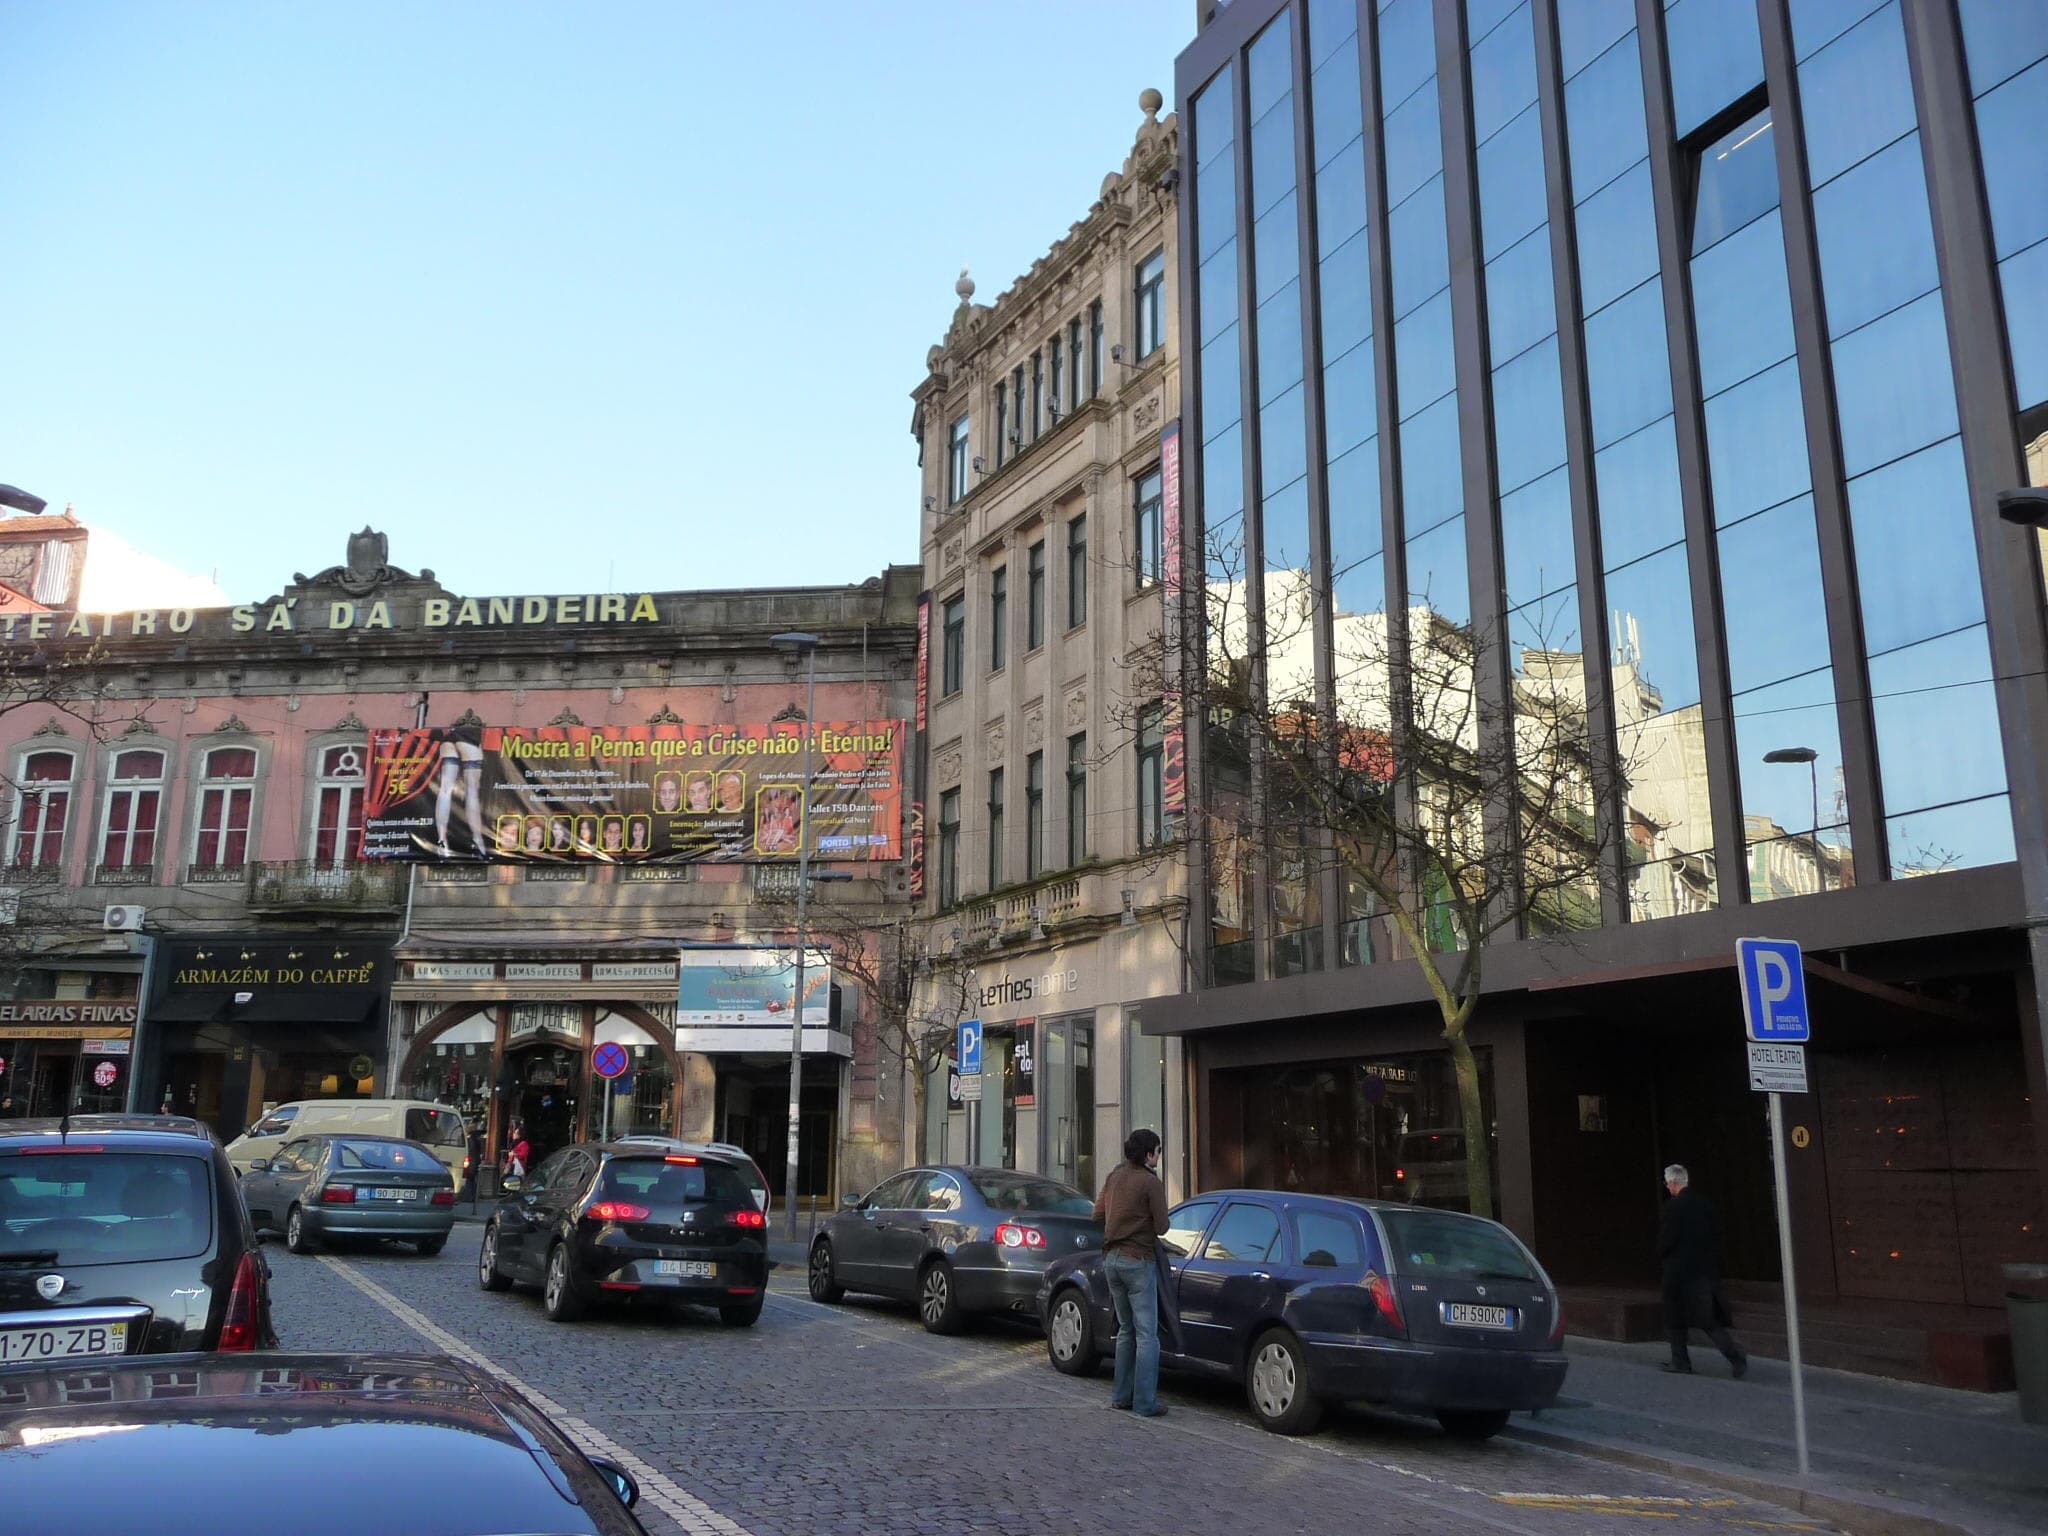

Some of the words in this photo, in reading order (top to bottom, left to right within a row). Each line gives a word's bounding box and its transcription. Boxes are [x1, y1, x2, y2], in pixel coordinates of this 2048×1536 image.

[0, 608, 193, 640] TEATRO
[231, 597, 298, 632] SÁ
[329, 600, 393, 630] DA
[424, 593, 659, 627] BANDEIRA
[500, 734, 570, 759] Mostra
[574, 739, 586, 758] a
[590, 734, 646, 758] Perna
[650, 739, 686, 765] que
[691, 740, 704, 756] a
[708, 731, 757, 756] Crise
[762, 731, 799, 755] não
[821, 727, 892, 754] Eterna!
[388, 778, 409, 796] 5€
[808, 804, 831, 813] allet
[174, 966, 271, 984] ARMAZÉM
[276, 968, 304, 984] DO
[310, 965, 371, 984] CAFFÈ
[416, 966, 450, 976] ARMAS
[466, 966, 492, 978] CAÇA
[506, 966, 537, 977] ARMAS
[545, 967, 580, 977] DEFESA
[594, 967, 623, 977] ARMAS
[632, 964, 674, 977] PRECISÃO
[1754, 949, 1791, 1030] P
[0, 1006, 77, 1021] ELARIAS
[80, 1006, 137, 1022] FINAS
[963, 1027, 975, 1068] P
[1751, 1047, 1774, 1063] HOTEL
[1775, 1048, 1801, 1065] TEATRO
[679, 1262, 693, 1273] LF
[695, 1263, 710, 1274] 95
[1452, 1305, 1467, 1321] CH
[1470, 1306, 1505, 1325] 590KG
[111, 1328, 124, 1336] 04
[112, 1342, 123, 1351] 10
